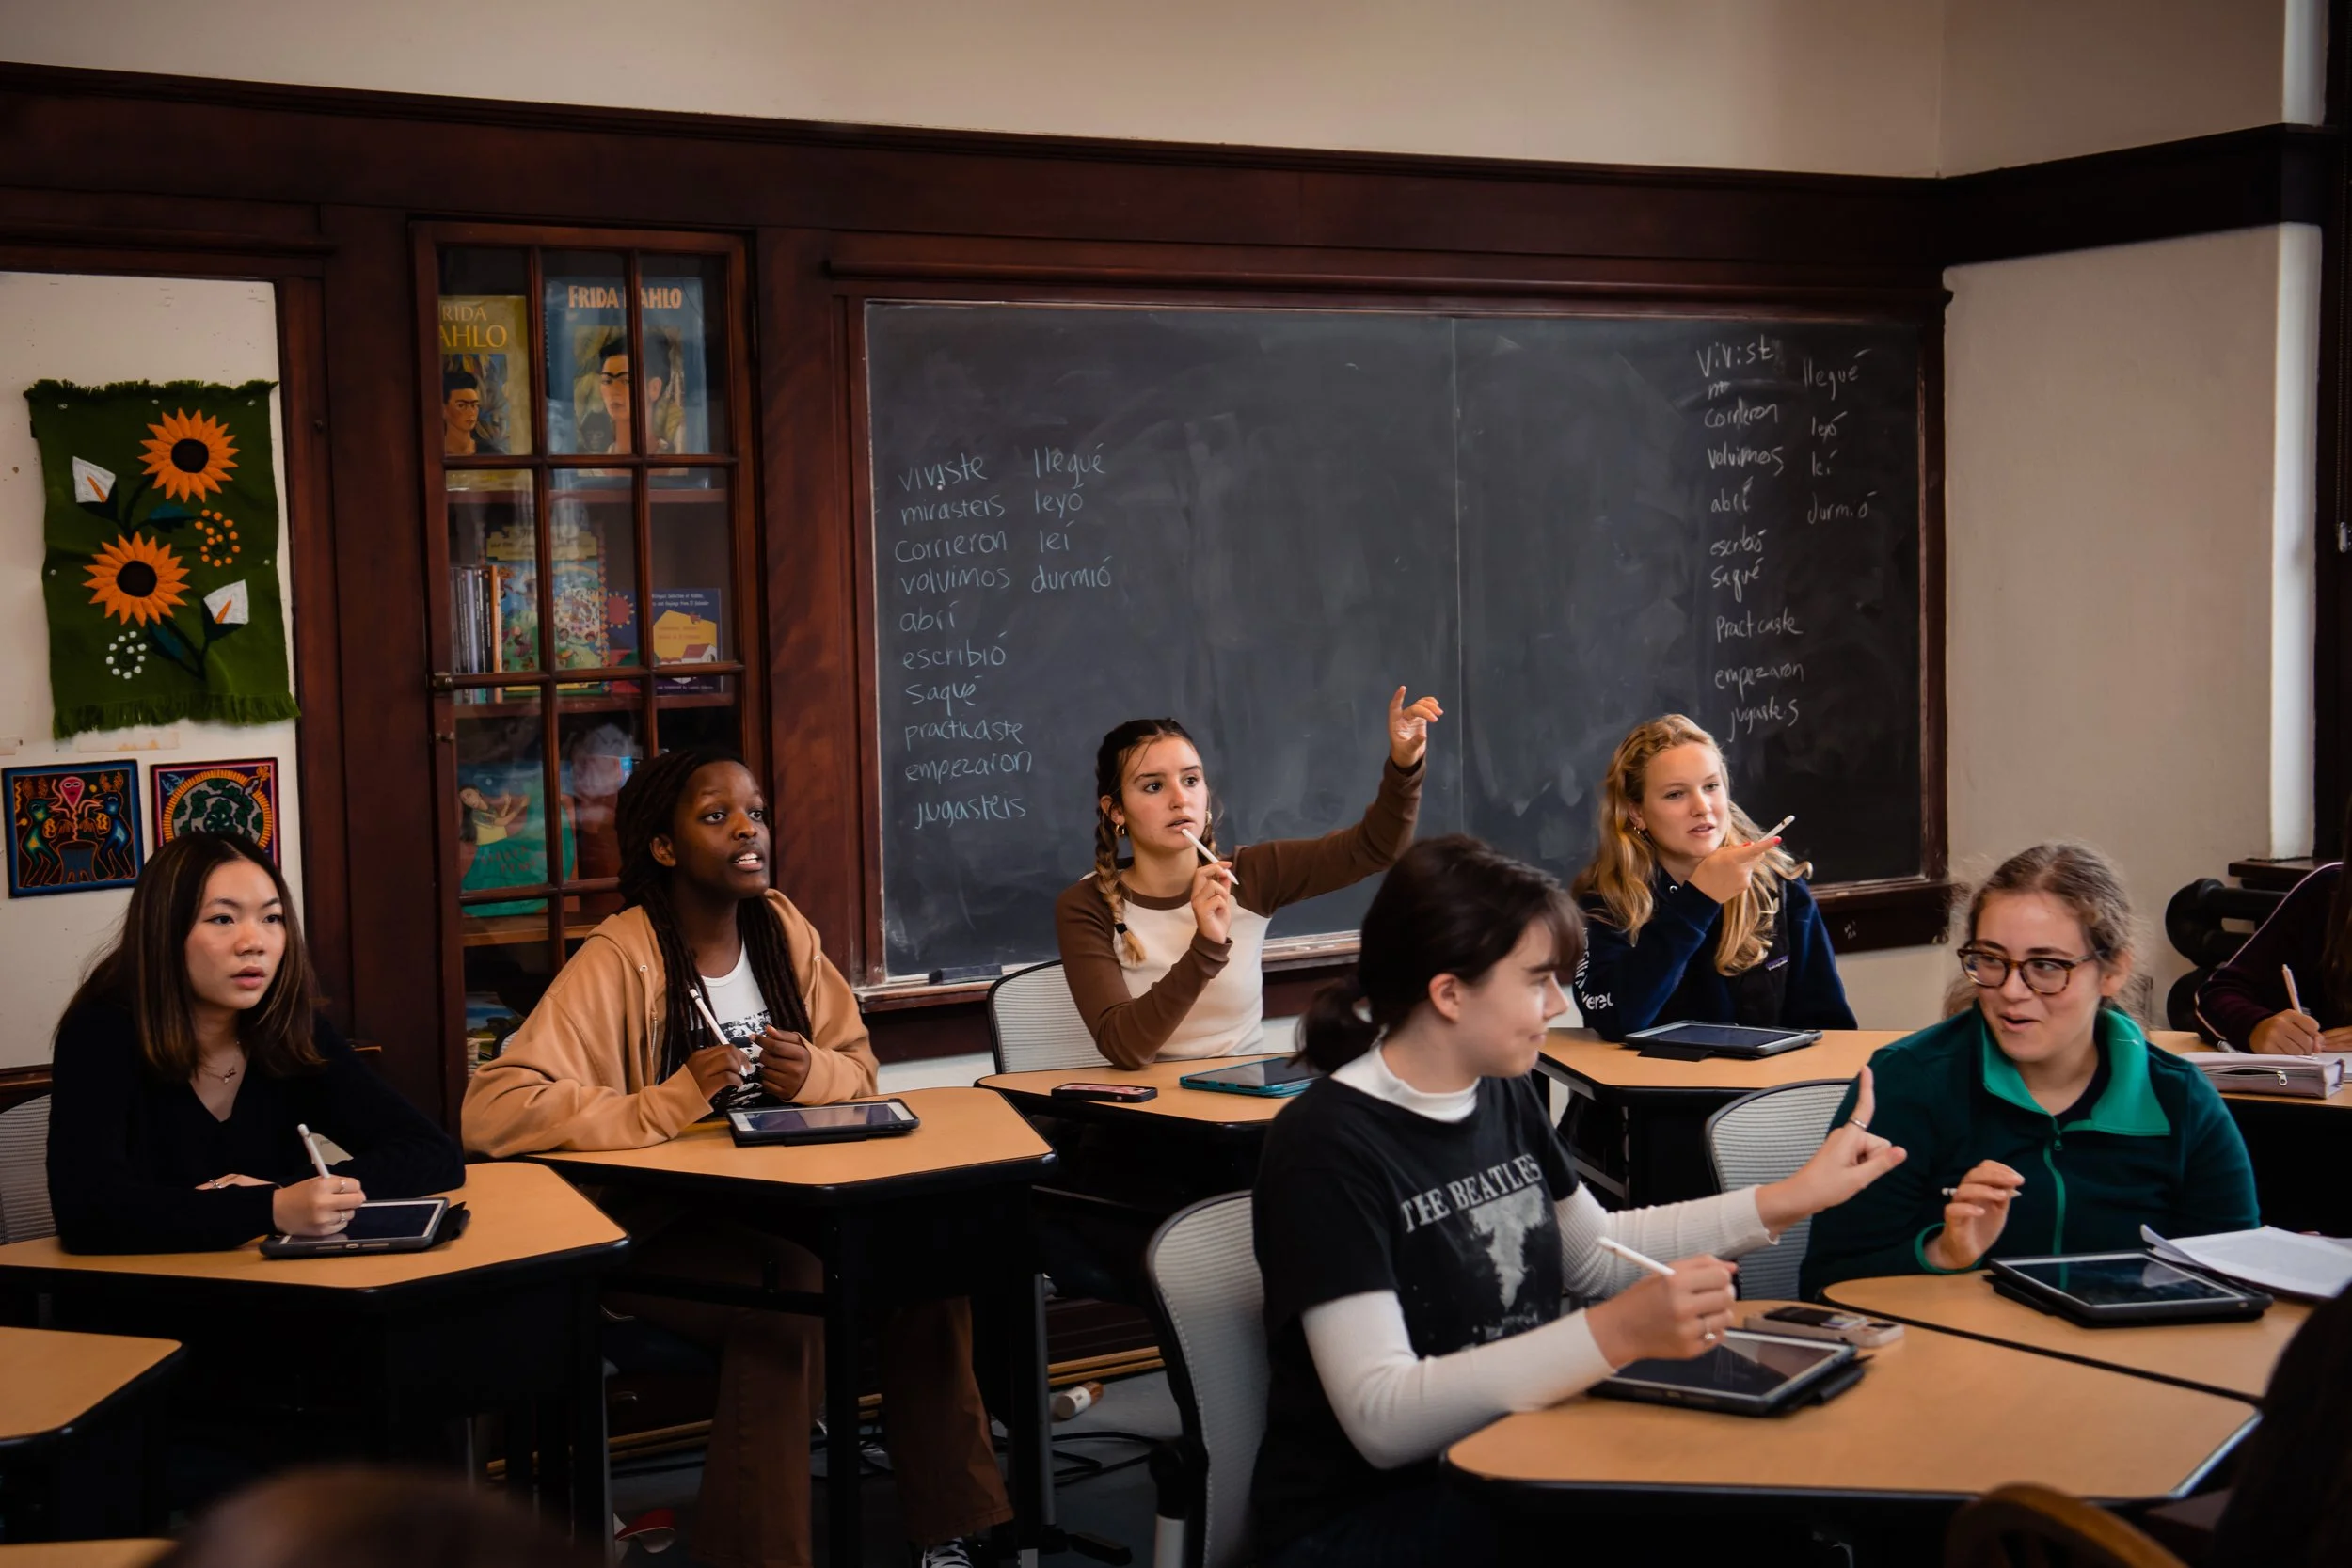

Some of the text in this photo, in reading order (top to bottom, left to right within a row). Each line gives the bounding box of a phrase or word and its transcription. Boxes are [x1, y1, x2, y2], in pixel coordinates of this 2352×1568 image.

[441, 304, 487, 321] RIDA
[568, 285, 682, 309] FRIDA AHLO
[438, 323, 508, 348] AHLO
[1804, 348, 1872, 401] llegué
[898, 452, 988, 491] viviste
[1034, 442, 1107, 489] llegué
[900, 493, 1006, 526] mirasteis
[895, 530, 1008, 562] corrieron
[1039, 520, 1075, 553] leí
[900, 564, 1011, 594] volvimos
[1031, 555, 1113, 593] durmió
[899, 600, 960, 632] abrí
[902, 631, 1008, 670] escribió
[905, 675, 983, 717] saqué
[1714, 662, 1804, 702] empezaron
[904, 751, 1033, 784] empezaron
[914, 794, 1026, 830] jugasteis
[1399, 1152, 1543, 1234] THE BEATLES
